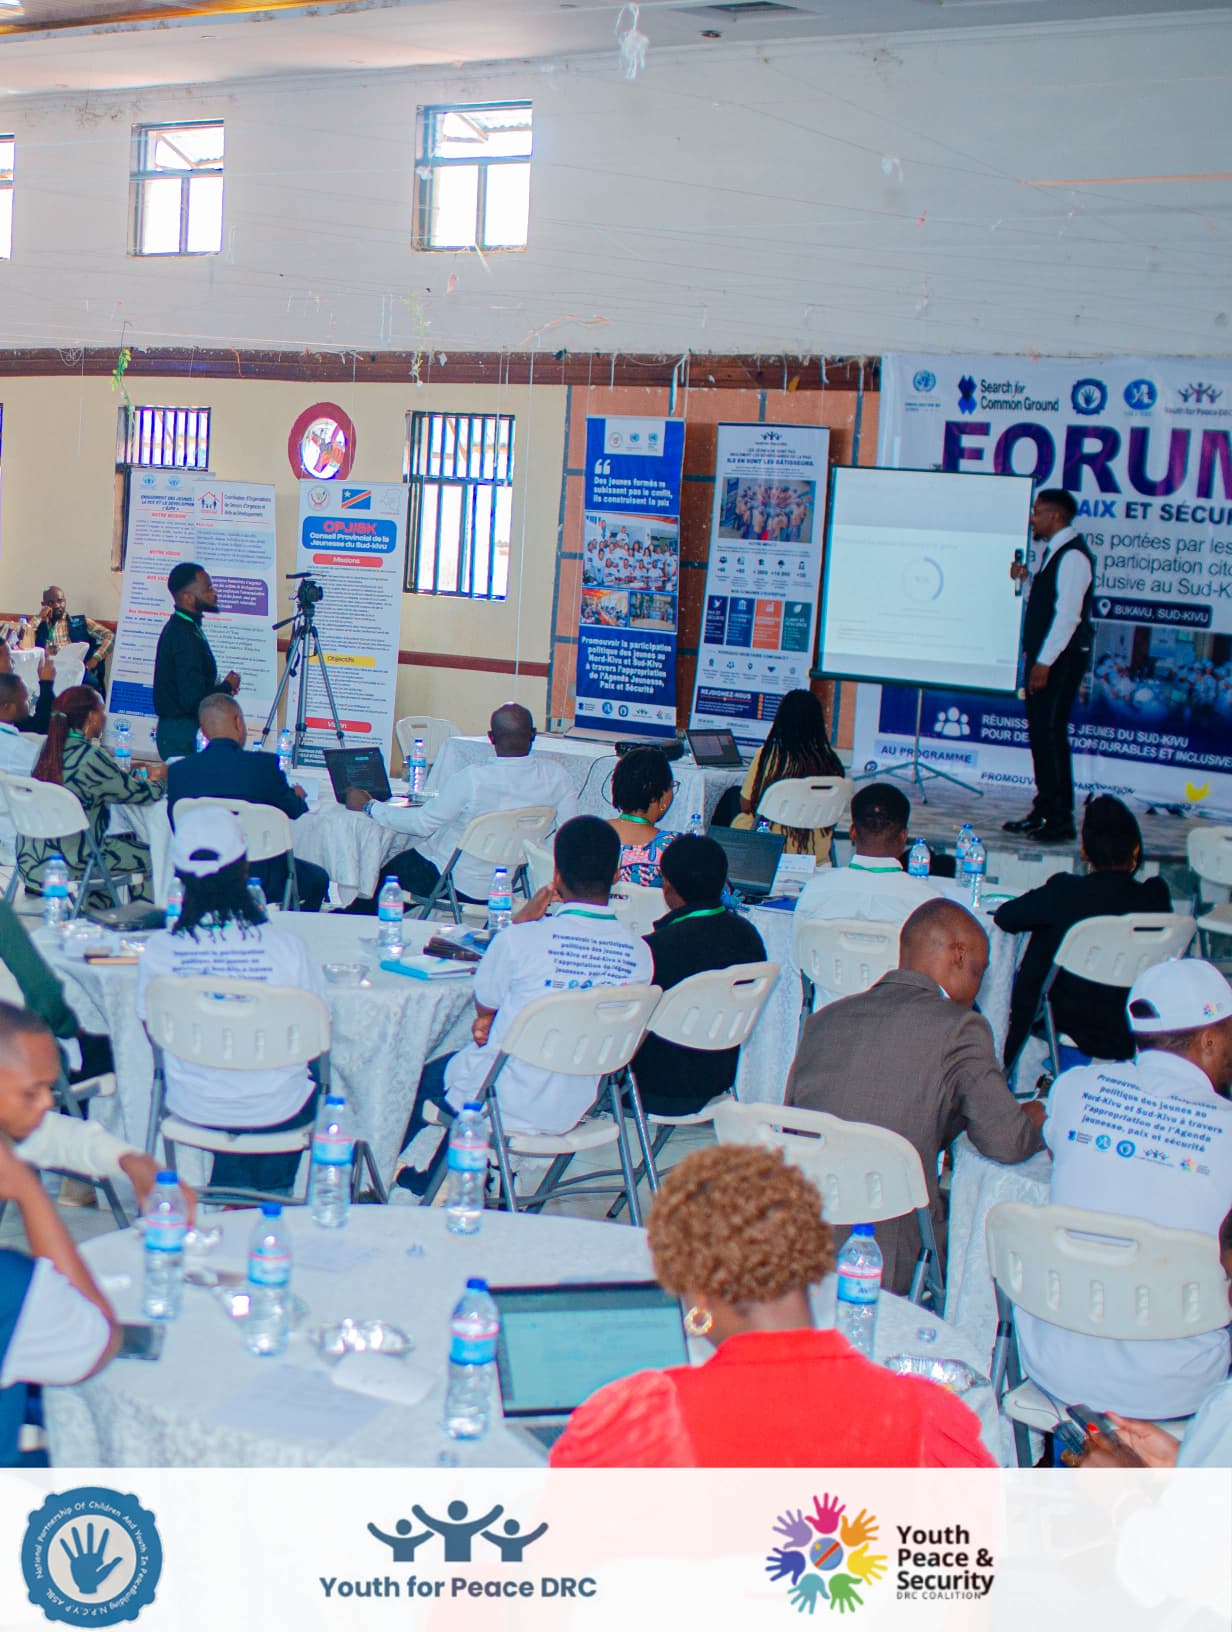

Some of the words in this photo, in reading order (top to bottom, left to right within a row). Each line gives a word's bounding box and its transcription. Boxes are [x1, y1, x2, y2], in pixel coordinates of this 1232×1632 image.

[981, 380, 1013, 394] Search
[1014, 384, 1025, 398] for
[981, 397, 1022, 410] Common
[1024, 400, 1059, 413] Ground
[1077, 500, 1116, 518] AIX
[1125, 502, 1151, 520] ET
[1160, 502, 1232, 525] SÉCU
[1110, 532, 1171, 550] portées
[1176, 538, 1205, 554] par
[1104, 555, 1203, 575] participation
[1150, 582, 1172, 593] au
[1115, 607, 1155, 619] BUKAVU,
[1158, 611, 1208, 623] SUD-KIVU
[982, 713, 1029, 729] RÉUNISS
[981, 729, 1011, 741] POUR
[1079, 725, 1115, 738] JEUNES
[1118, 729, 1134, 741] DU
[1137, 731, 1189, 748] SUD-KIVU
[881, 746, 896, 755] AU
[1099, 740, 1157, 758] DURABLES
[1159, 749, 1175, 760] ET
[981, 772, 1034, 785] PROMOUV
[1100, 1086, 1138, 1102] politique
[1141, 1098, 1157, 1107] des
[1160, 1102, 1192, 1115] jeunes
[1195, 1111, 1207, 1119] au
[1082, 1093, 1122, 1108] Nord-Kivu
[1124, 1104, 1134, 1112] et
[1137, 1106, 1177, 1124] Sud-Kivu
[1180, 1117, 1185, 1125] à
[1189, 1120, 1223, 1135] travers
[1154, 1121, 1166, 1132] de
[1128, 1129, 1148, 1139] paix
[1152, 1133, 1161, 1142] et
[1164, 1136, 1205, 1153] sécurité
